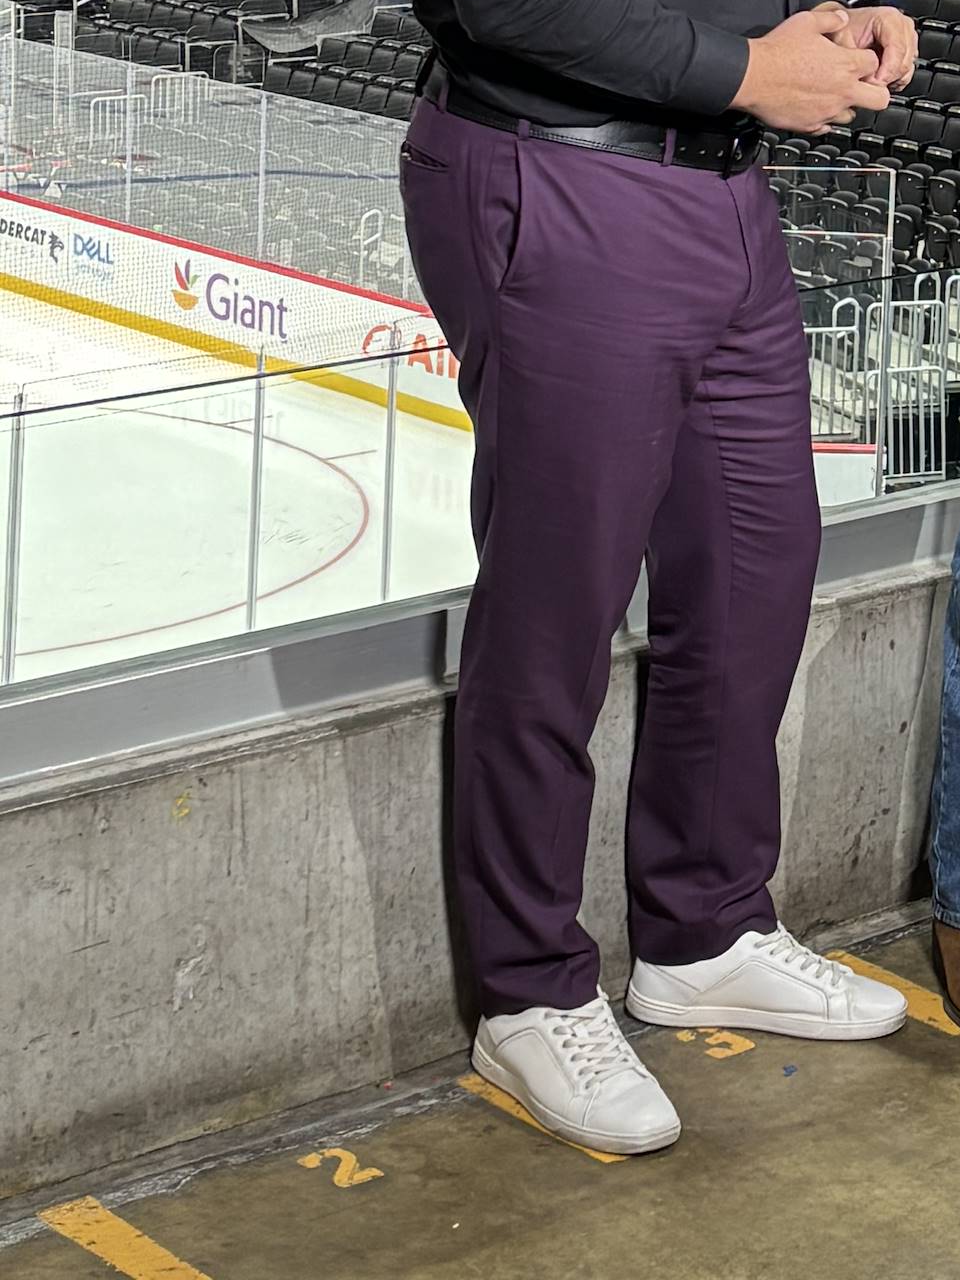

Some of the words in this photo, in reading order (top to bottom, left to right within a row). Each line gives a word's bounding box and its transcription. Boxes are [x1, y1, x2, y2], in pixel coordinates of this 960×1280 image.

[0, 218, 47, 246] DERCAT
[74, 233, 114, 265] DELL
[206, 273, 287, 339] Giant
[297, 1148, 385, 1188] 2
